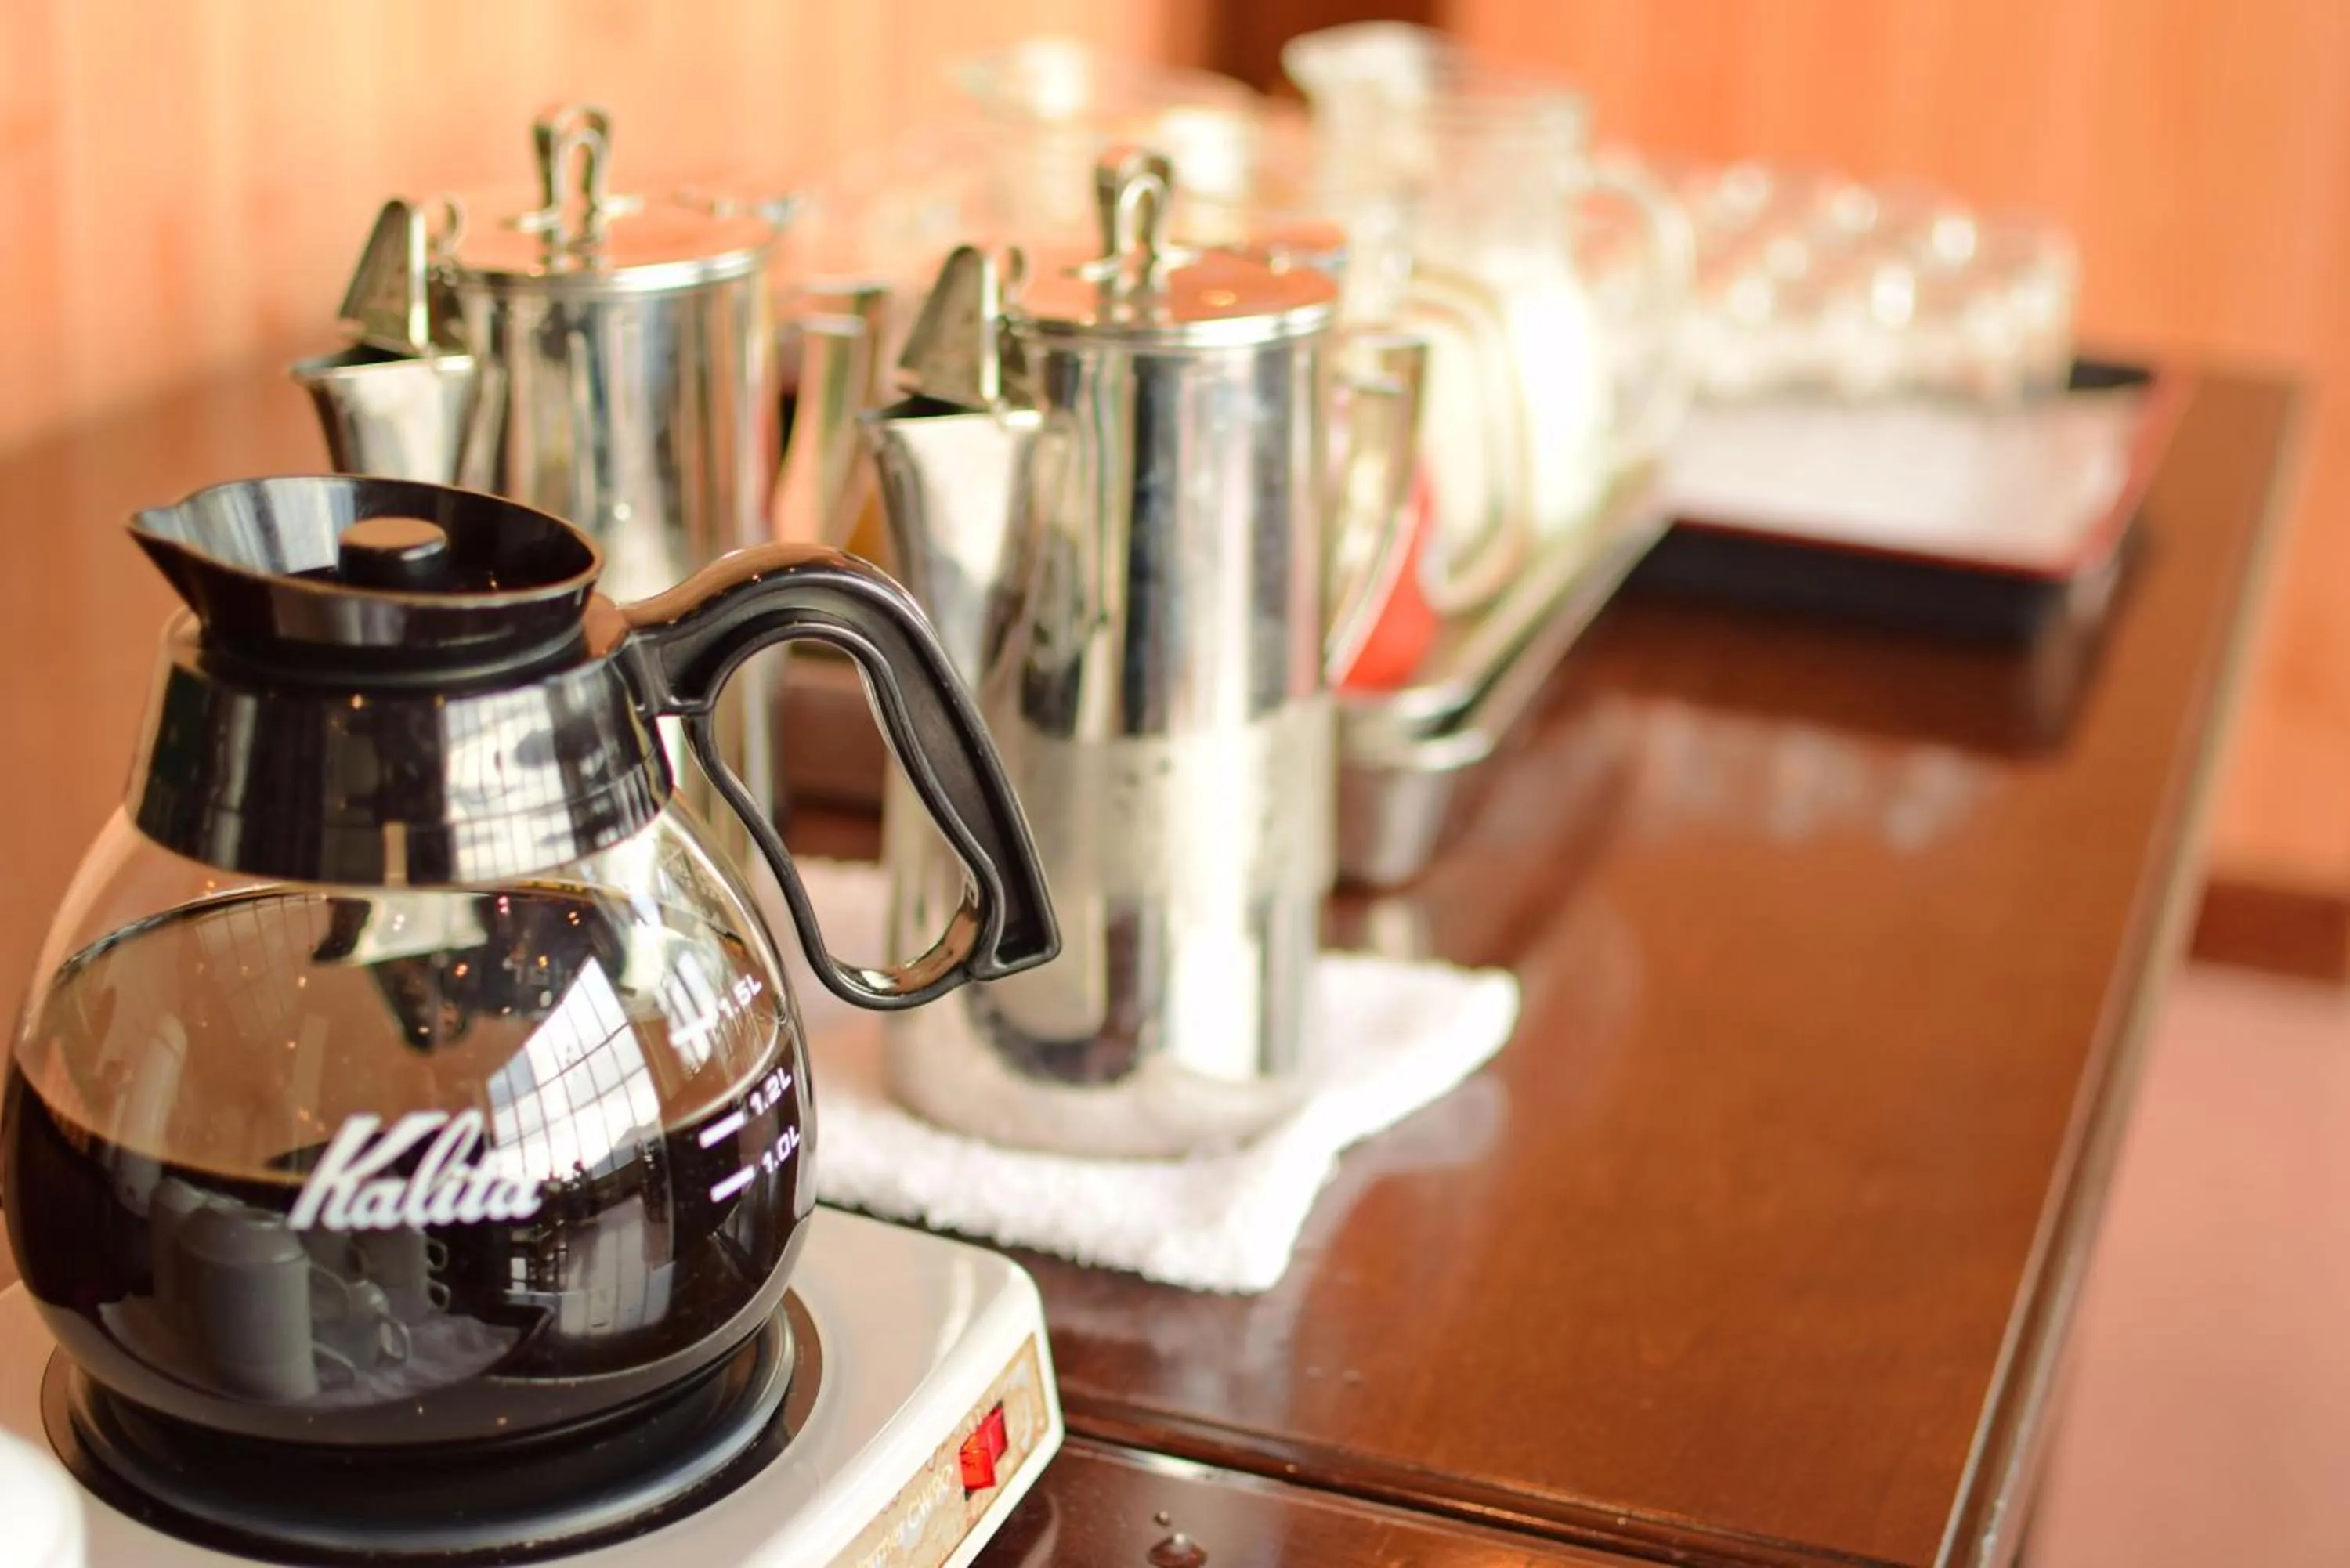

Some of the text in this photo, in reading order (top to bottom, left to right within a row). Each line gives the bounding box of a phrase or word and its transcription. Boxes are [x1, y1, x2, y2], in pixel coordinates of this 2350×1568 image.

[718, 974, 762, 1017] 1.5L
[749, 1068, 792, 1115] 1.2L
[287, 1107, 544, 1230] Kalita
[762, 1125, 800, 1174] 1.0L
